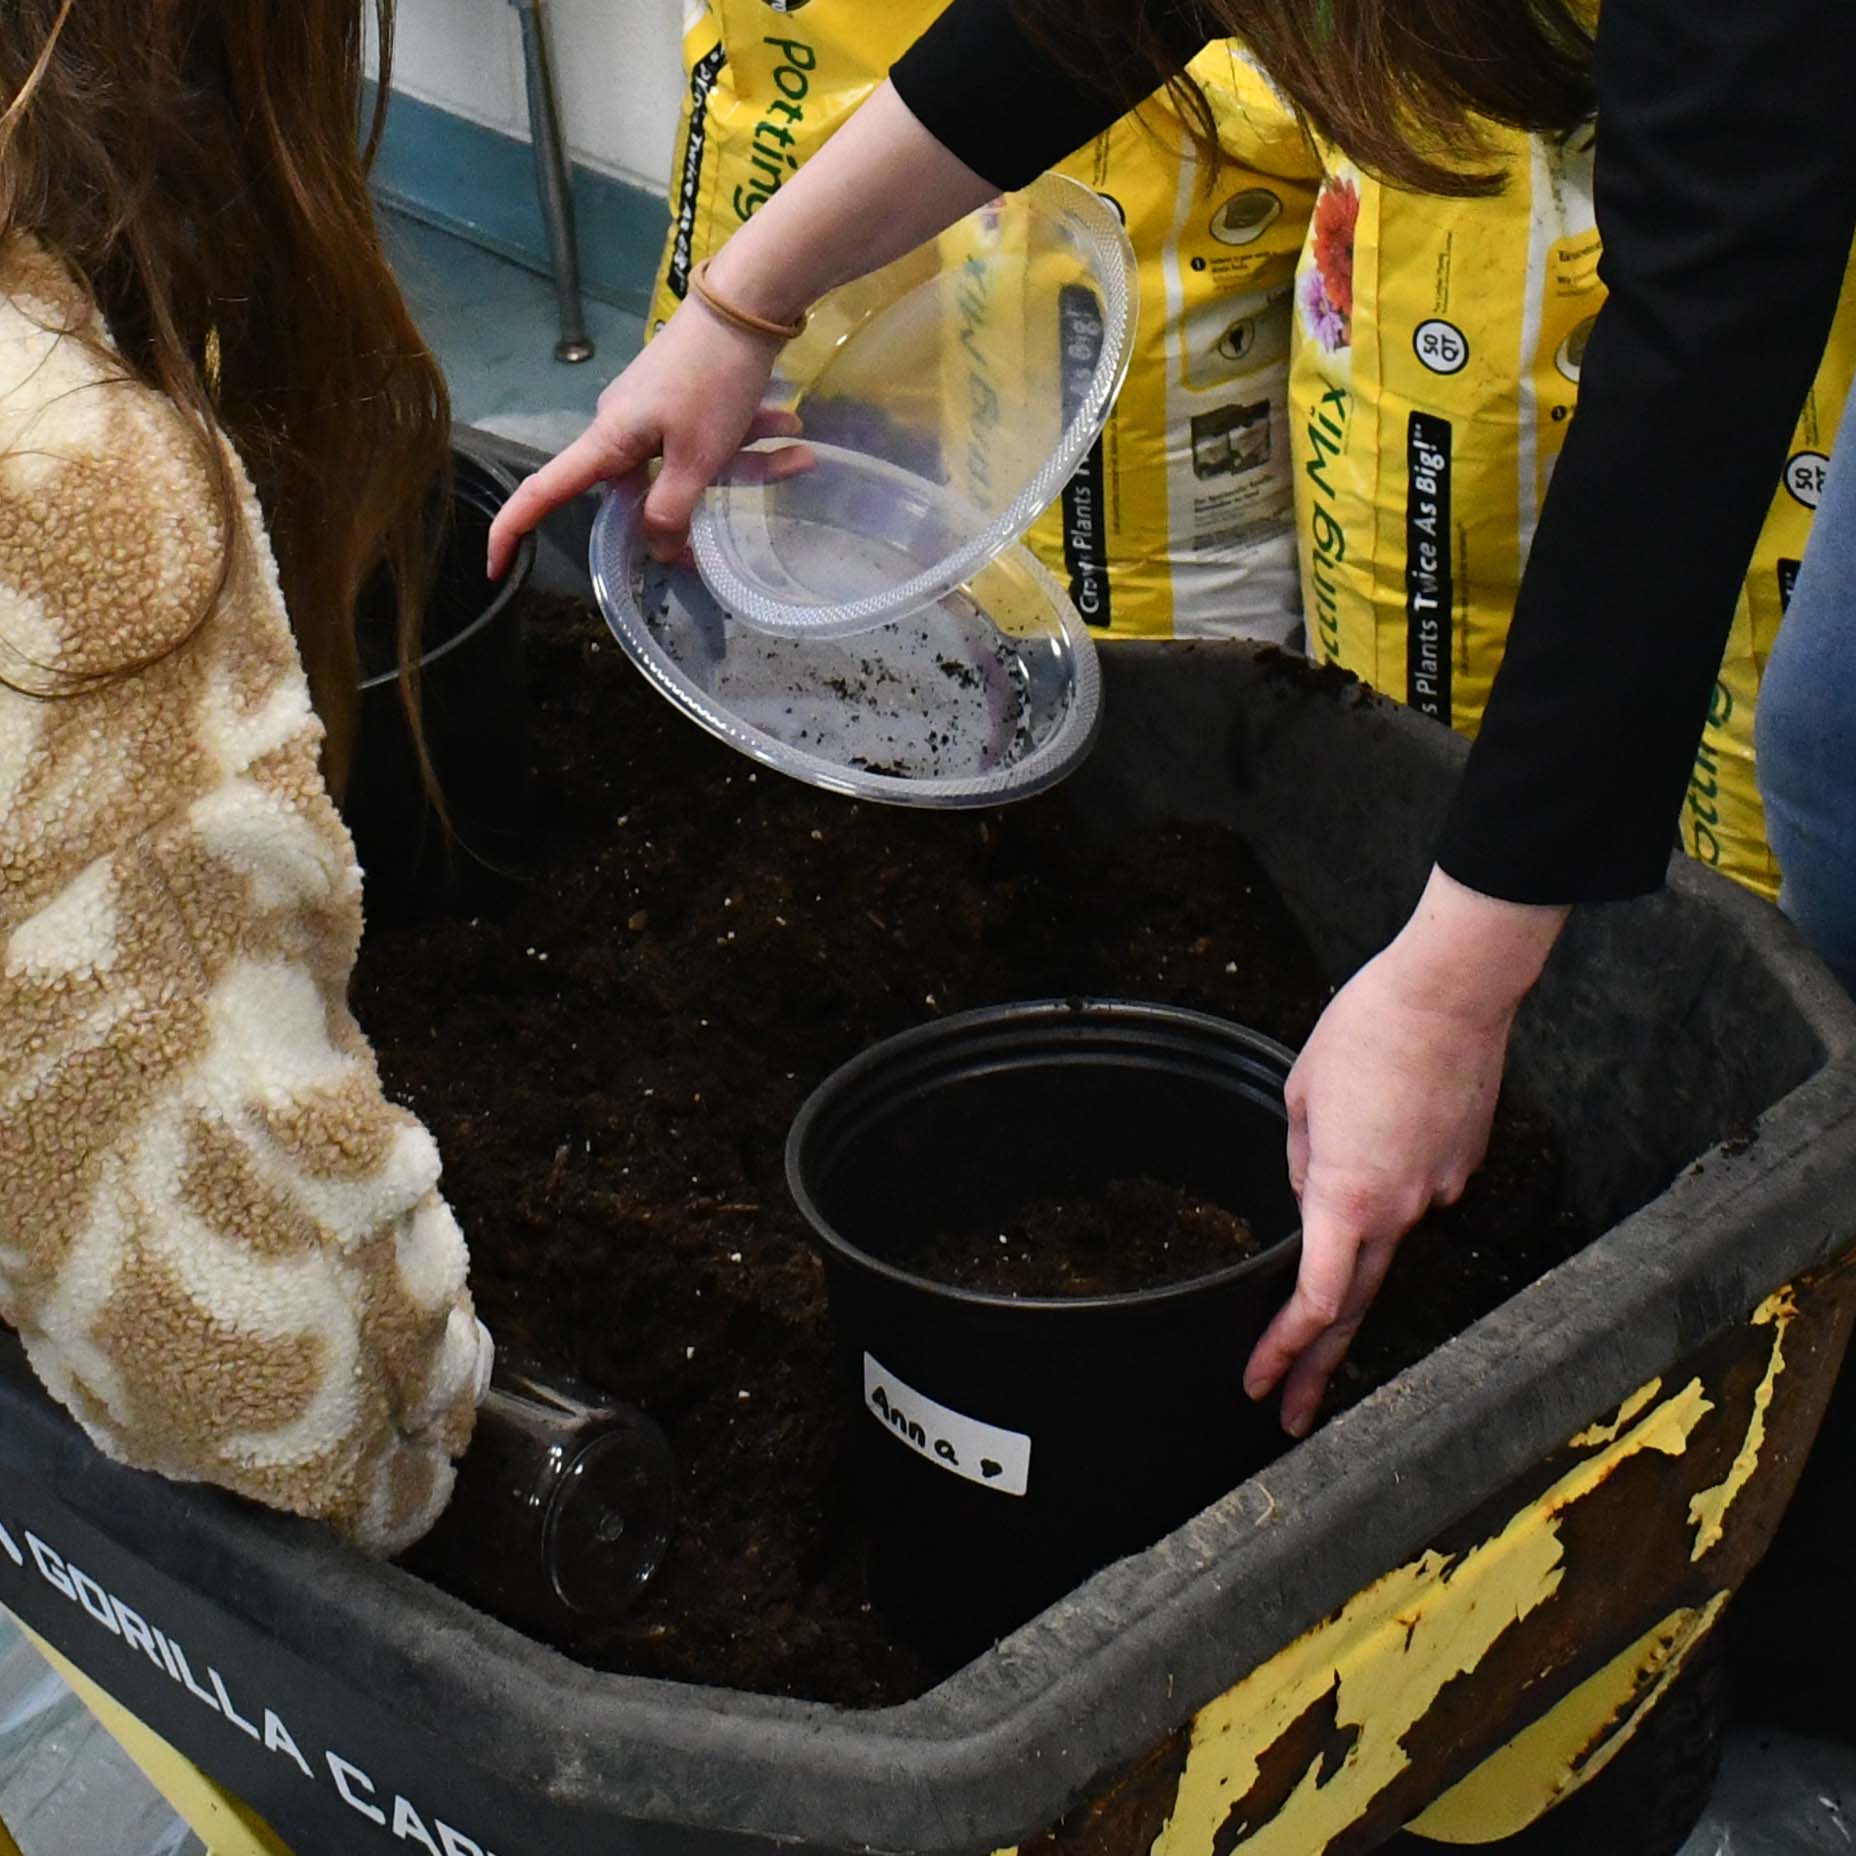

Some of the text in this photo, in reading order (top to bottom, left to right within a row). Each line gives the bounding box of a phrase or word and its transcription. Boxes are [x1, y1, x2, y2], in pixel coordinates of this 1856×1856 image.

[1423, 333, 1439, 356] 50
[1441, 333, 1460, 363] QT
[1304, 373, 1348, 500] Mix
[1795, 467, 1814, 491] 50
[1413, 502, 1439, 539] As
[1411, 543, 1439, 612] Twice
[1415, 620, 1439, 694] Plants
[24, 1528, 315, 1781] GORILLA
